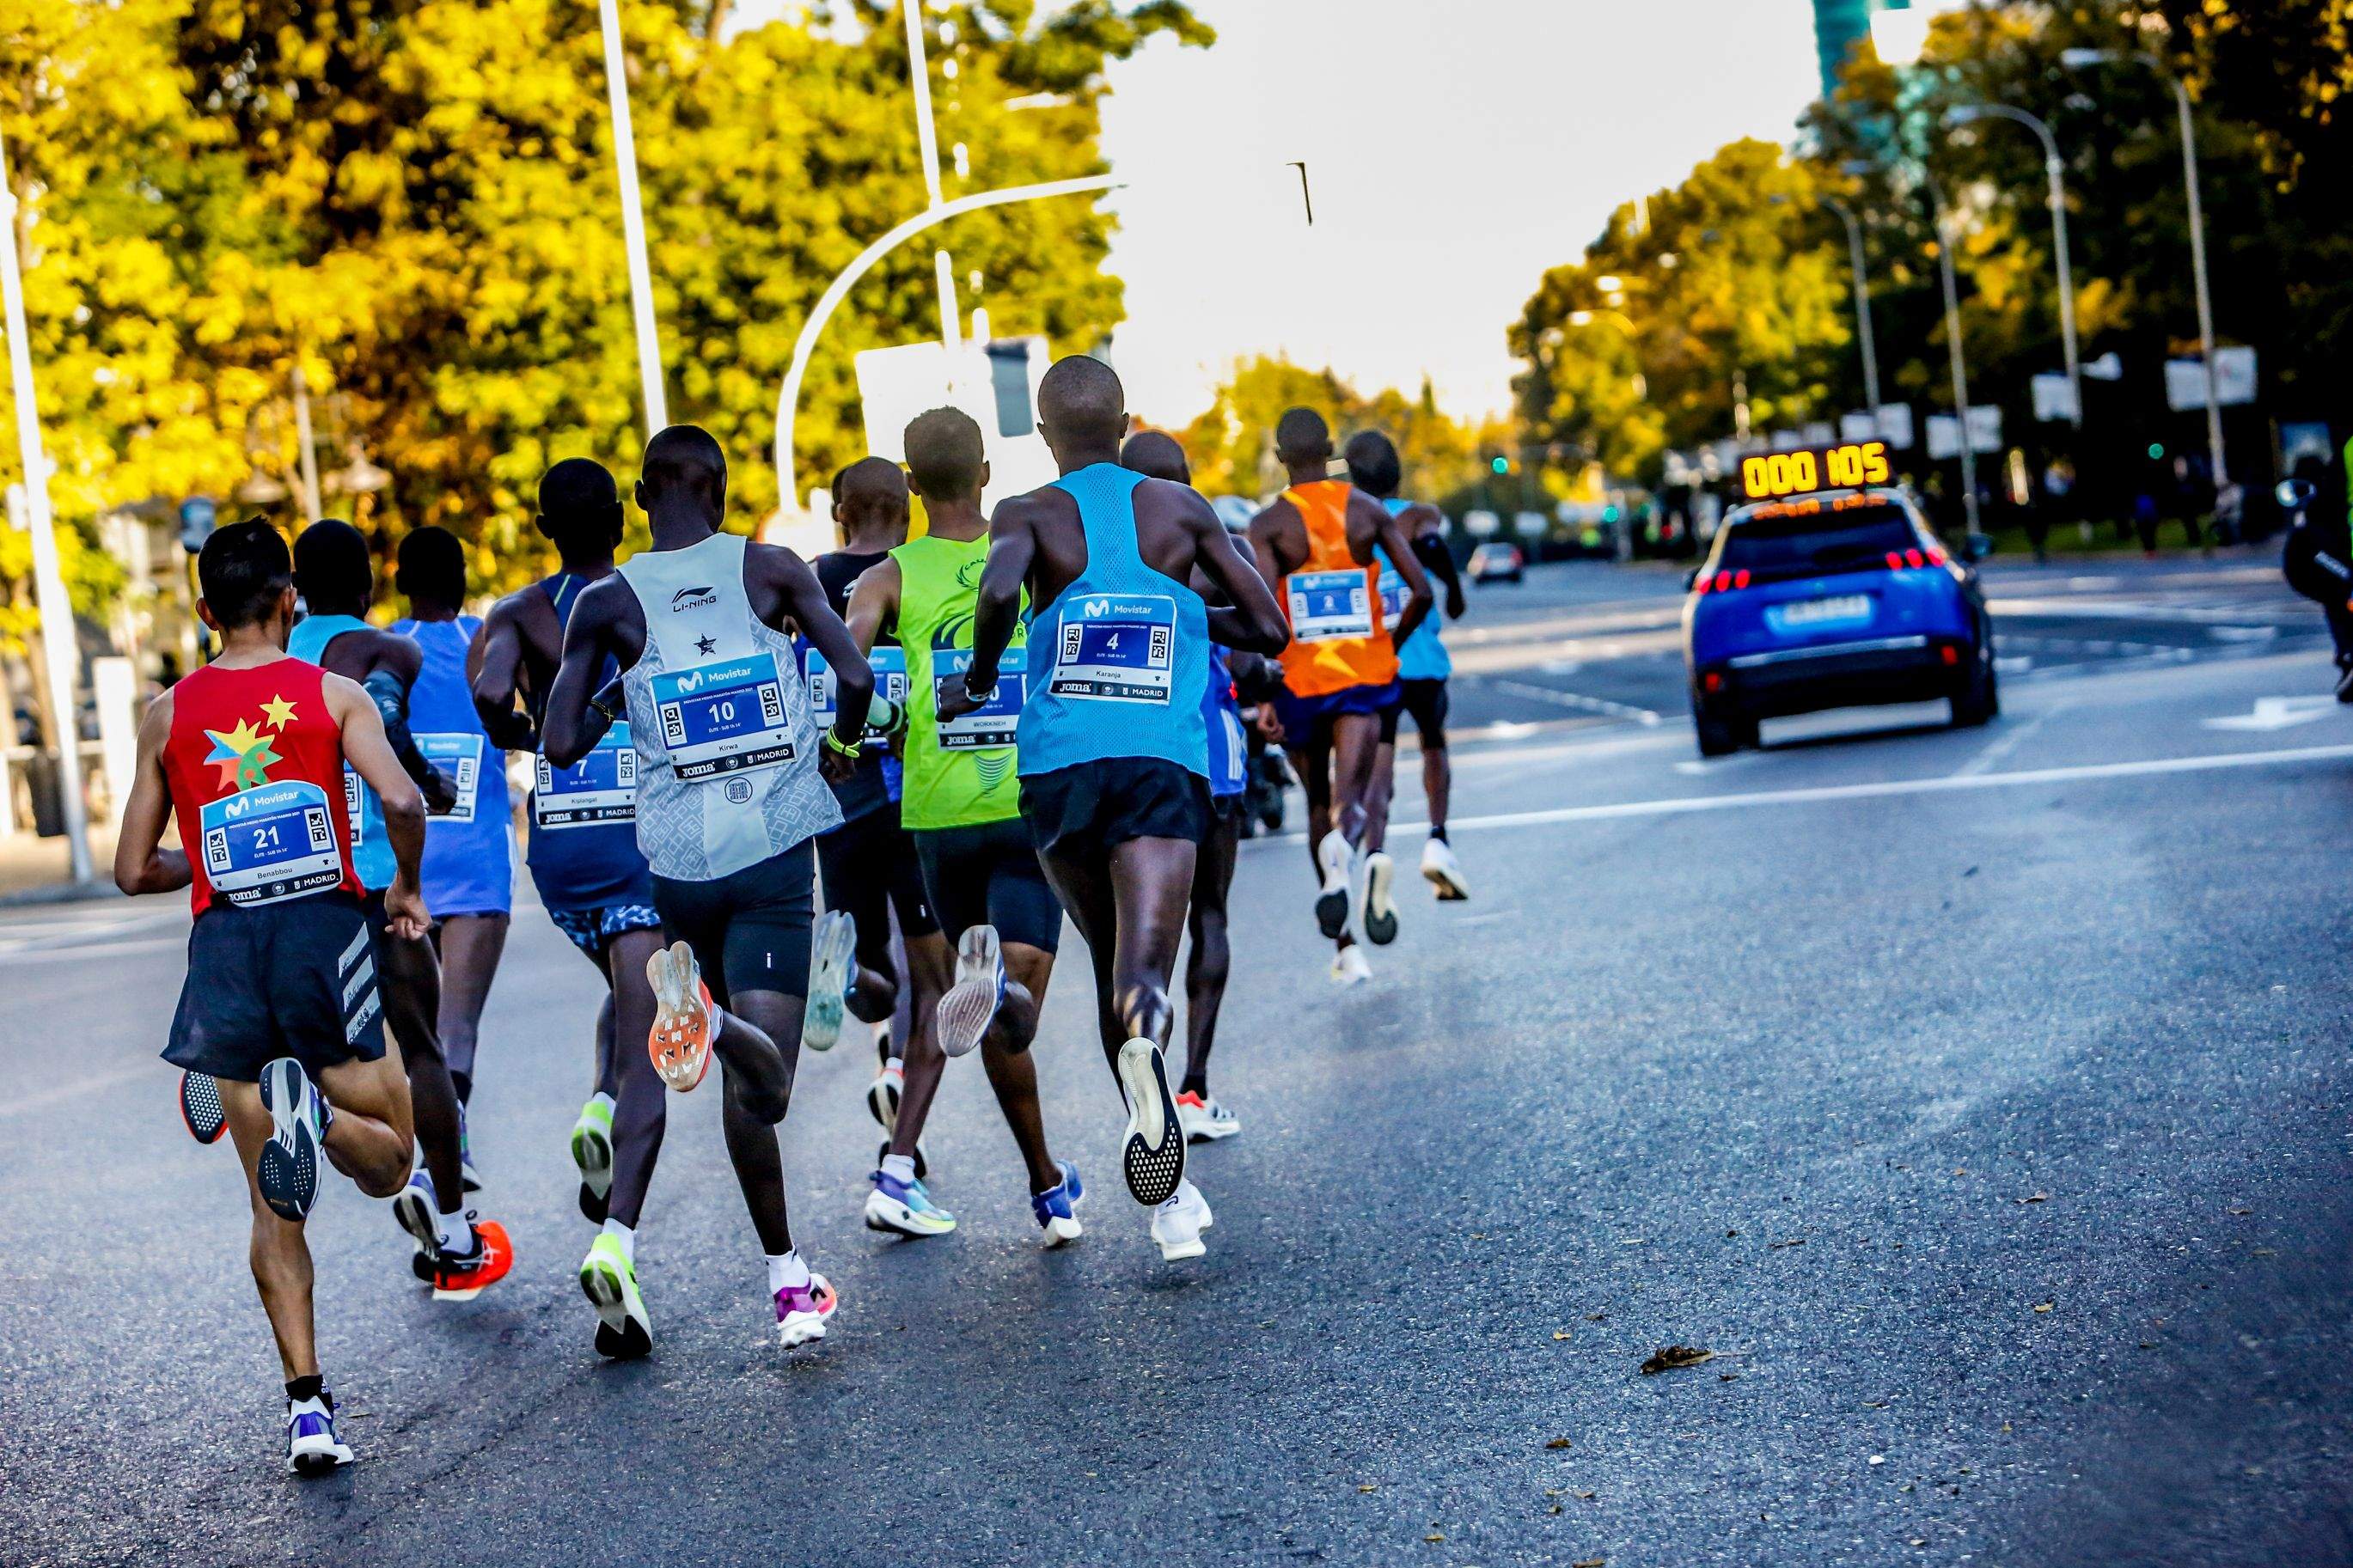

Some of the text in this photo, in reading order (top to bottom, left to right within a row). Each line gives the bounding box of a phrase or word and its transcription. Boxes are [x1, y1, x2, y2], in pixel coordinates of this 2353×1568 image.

[673, 595, 717, 613] LI-NING
[1114, 605, 1152, 614] Movistar
[1107, 632, 1119, 650] 4
[708, 667, 751, 682] Movistar
[1096, 670, 1121, 679] Karanja
[1132, 688, 1164, 697] MADRID
[708, 701, 735, 723] 10
[718, 743, 738, 752] Kirwa
[757, 748, 789, 761] MADRID
[576, 759, 588, 777] 7
[254, 790, 299, 807] Movistar
[606, 808, 635, 817] MADRID
[253, 826, 280, 850] 21
[257, 867, 293, 879] Benabbou
[303, 873, 337, 887] MADRID
